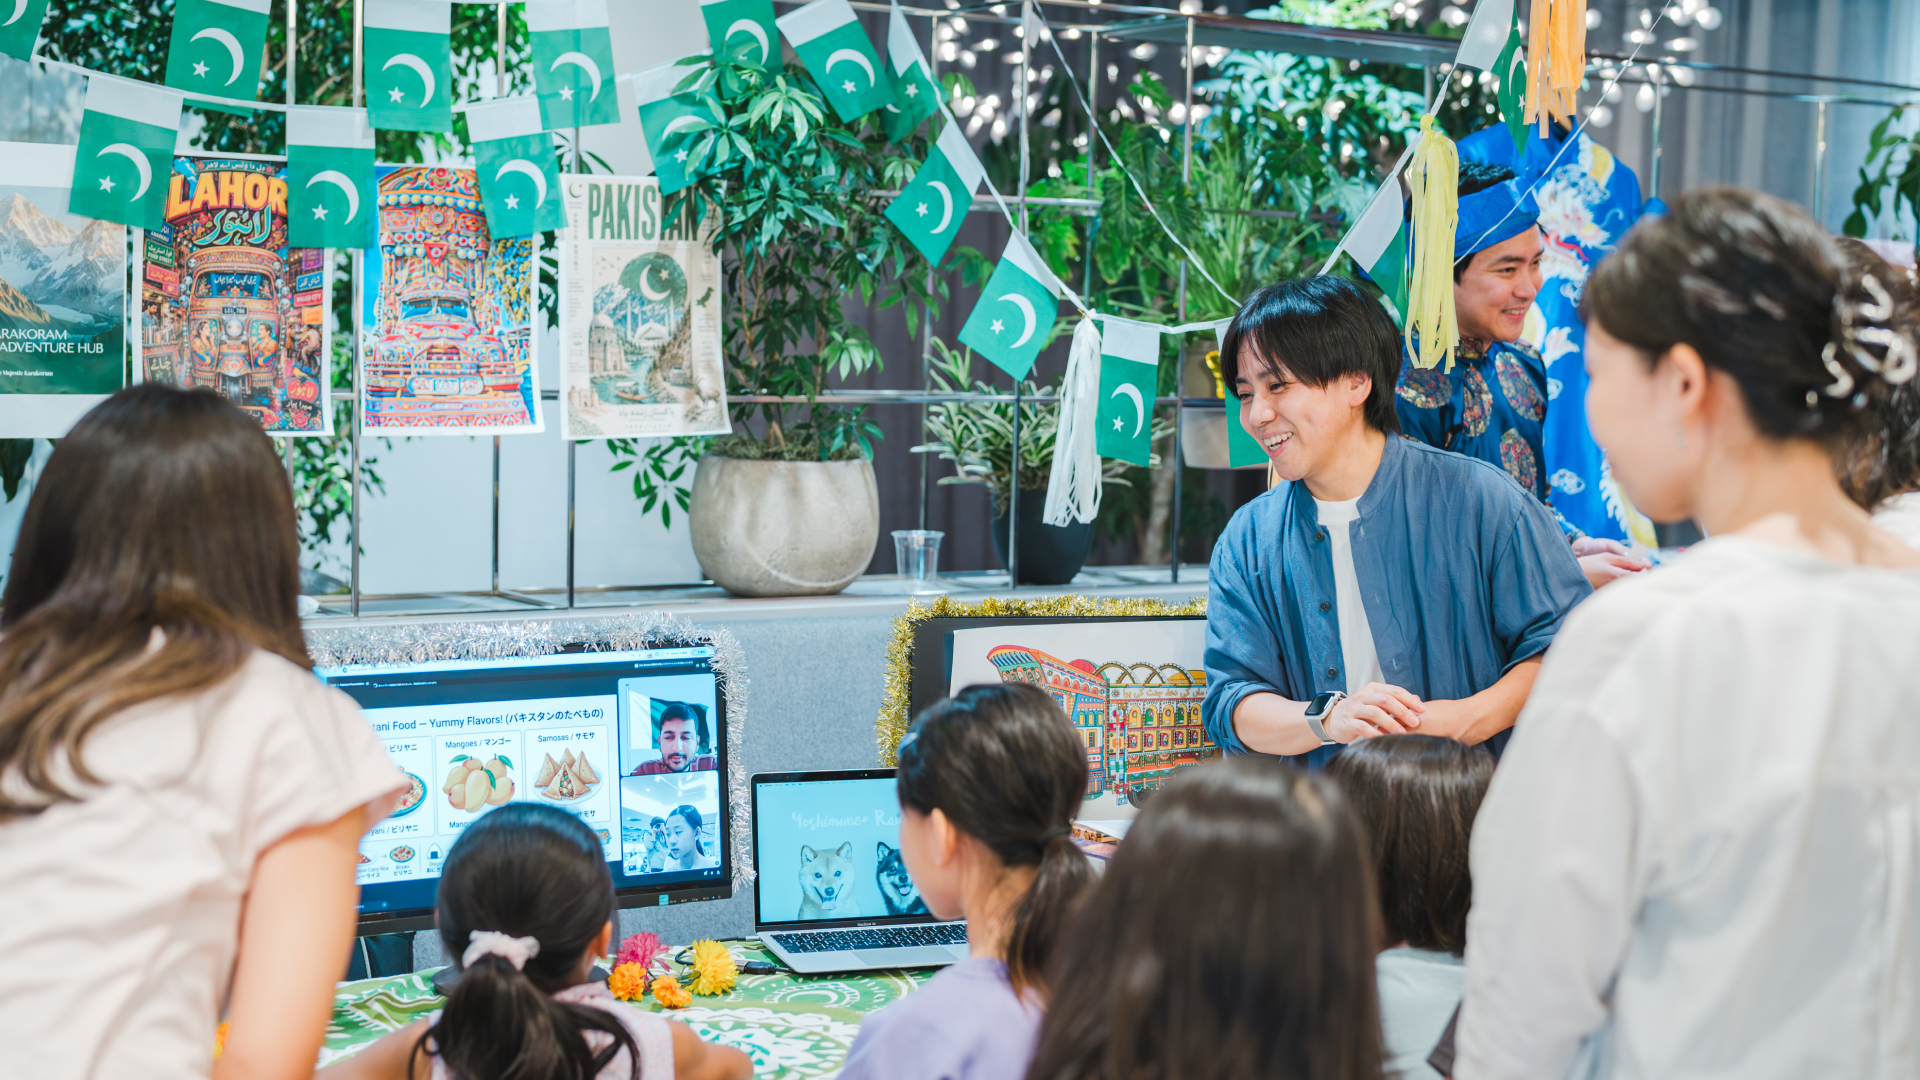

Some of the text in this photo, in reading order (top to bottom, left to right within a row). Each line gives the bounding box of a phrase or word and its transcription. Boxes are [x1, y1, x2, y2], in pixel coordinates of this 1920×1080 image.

[168, 172, 288, 219] LAHOR
[0, 329, 67, 340] RAKORAM
[0, 342, 104, 353] ADVENTURE HUB
[393, 720, 417, 730] Food
[429, 718, 465, 729] Yummy
[467, 715, 503, 726] Flavors!
[505, 708, 604, 725] (パキスタンのたべもの)
[537, 734, 569, 742] Samosas
[575, 732, 595, 740] サモサ
[390, 744, 418, 752] ビリヤニ
[445, 740, 478, 749] Mangoes
[484, 737, 512, 746] マンゴー
[391, 824, 419, 834] ビリヤニ
